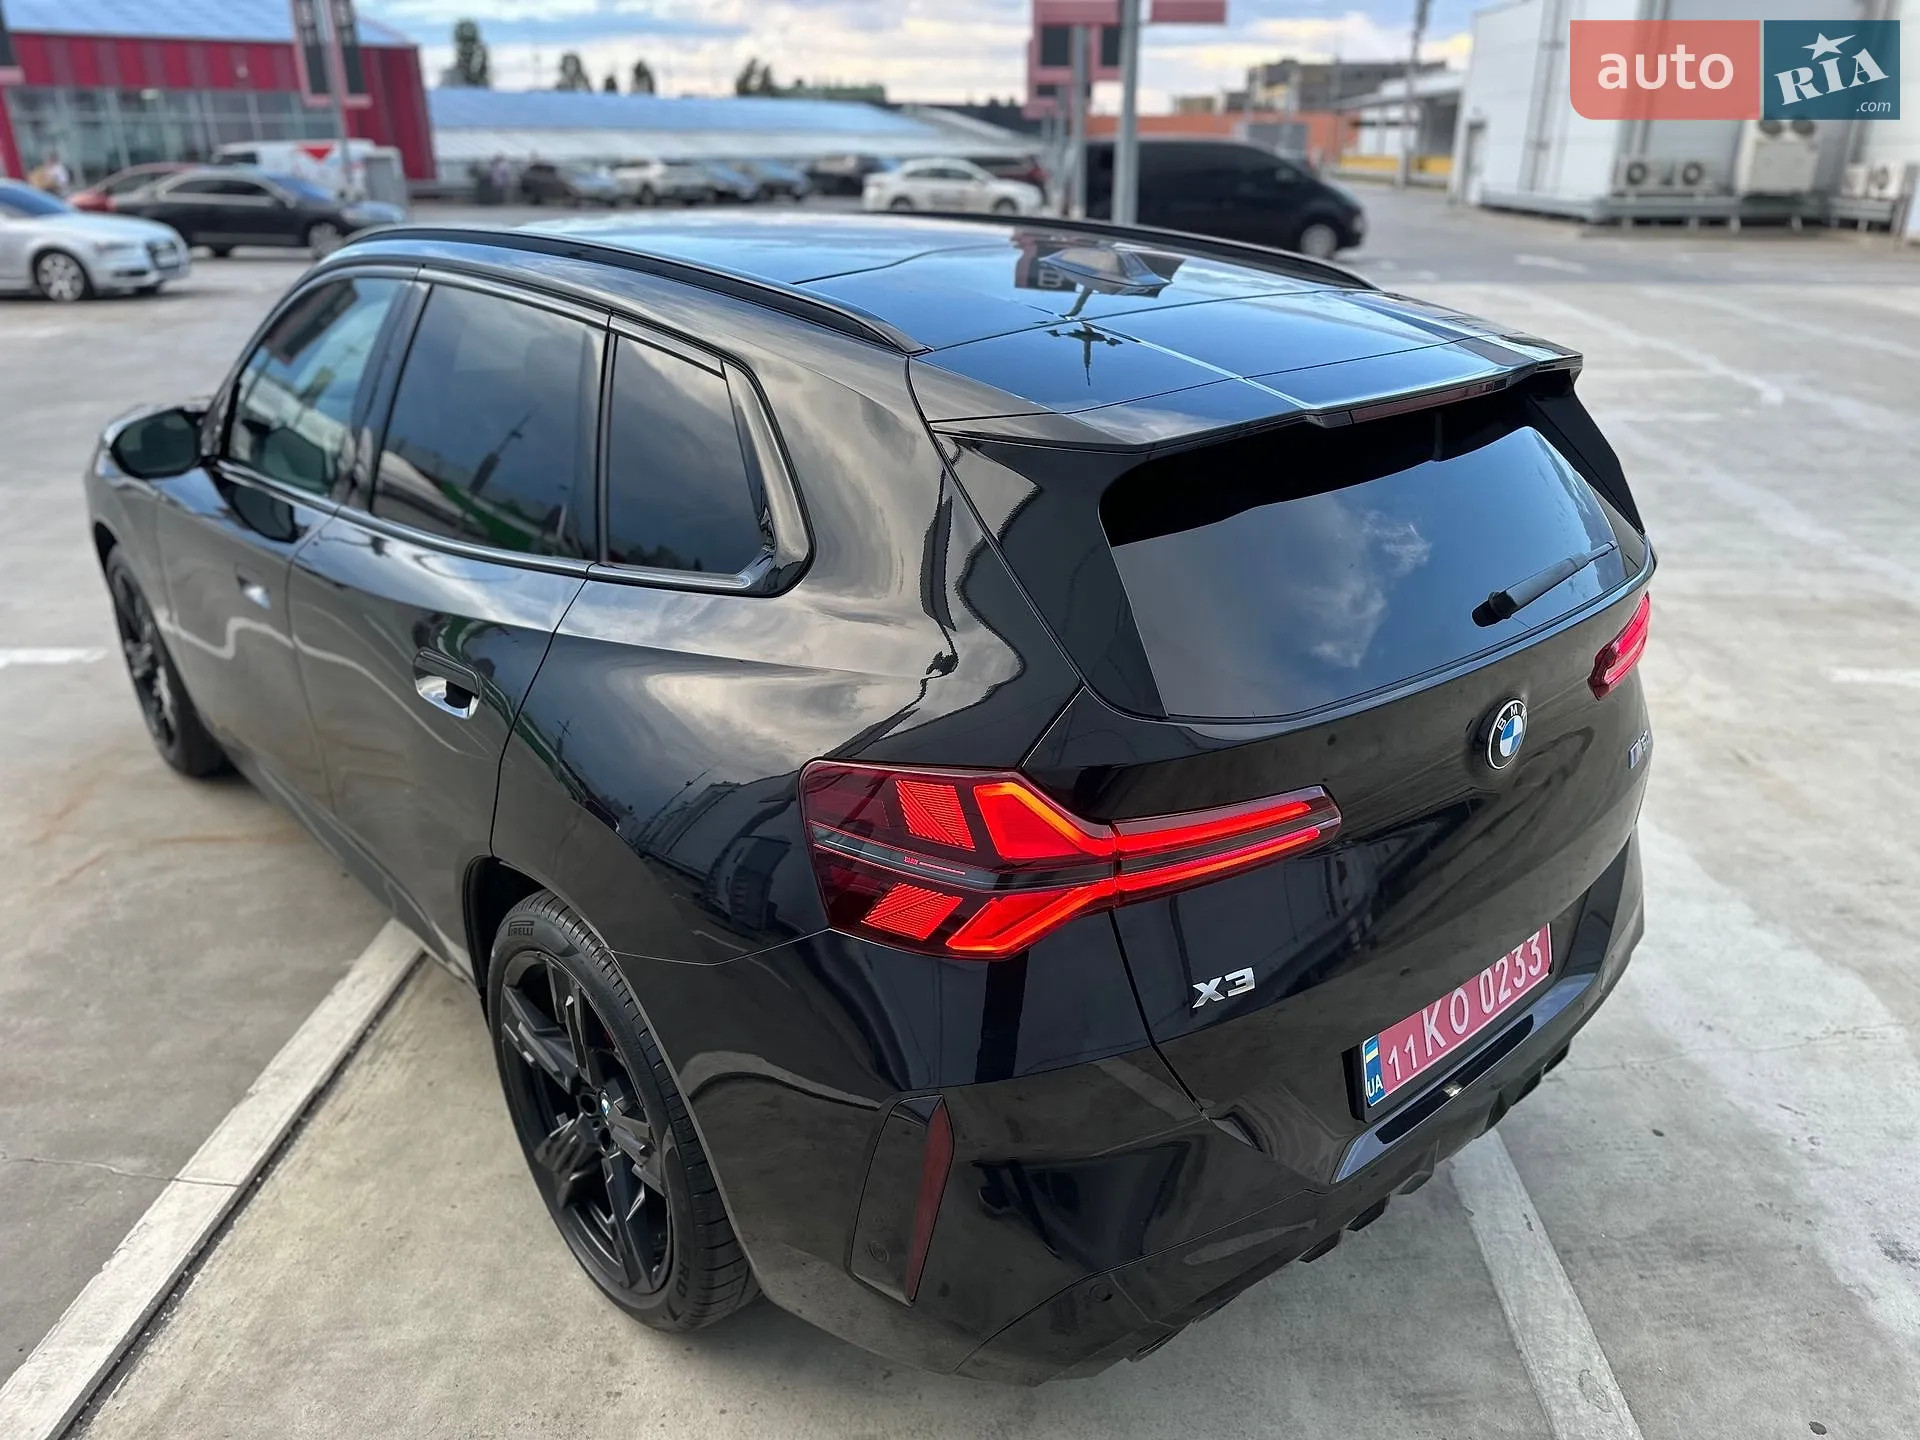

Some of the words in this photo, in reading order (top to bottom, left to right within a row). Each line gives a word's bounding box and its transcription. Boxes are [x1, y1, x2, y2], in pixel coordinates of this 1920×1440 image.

[1497, 703, 1527, 731] BMW
[1192, 967, 1255, 1008] X3
[1478, 931, 1542, 1015] 0233
[1367, 1074, 1384, 1097] UA
